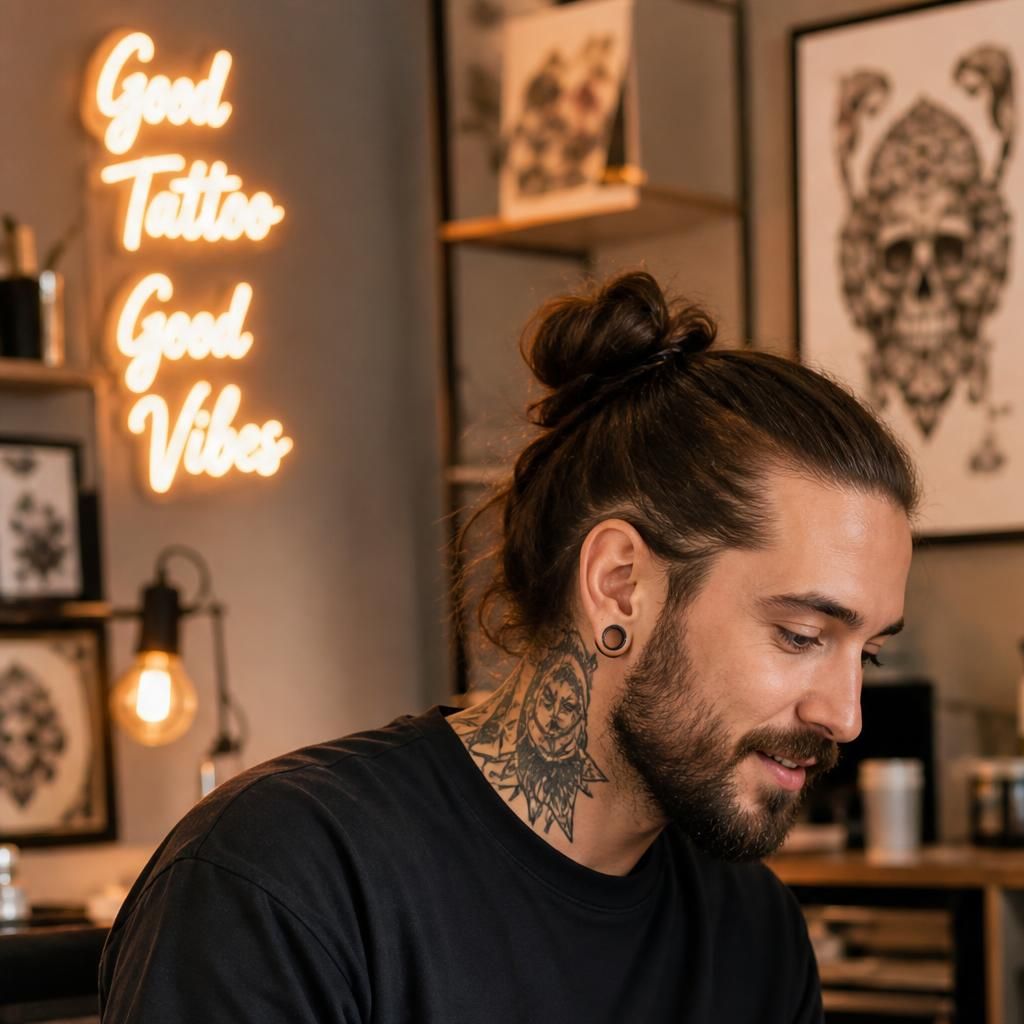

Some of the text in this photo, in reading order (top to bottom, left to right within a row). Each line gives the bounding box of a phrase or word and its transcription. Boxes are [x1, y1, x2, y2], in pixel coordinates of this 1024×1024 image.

[95, 31, 234, 156] Good
[99, 152, 286, 252] Tattoo
[115, 272, 254, 394] Good
[126, 380, 294, 494] Vibes
